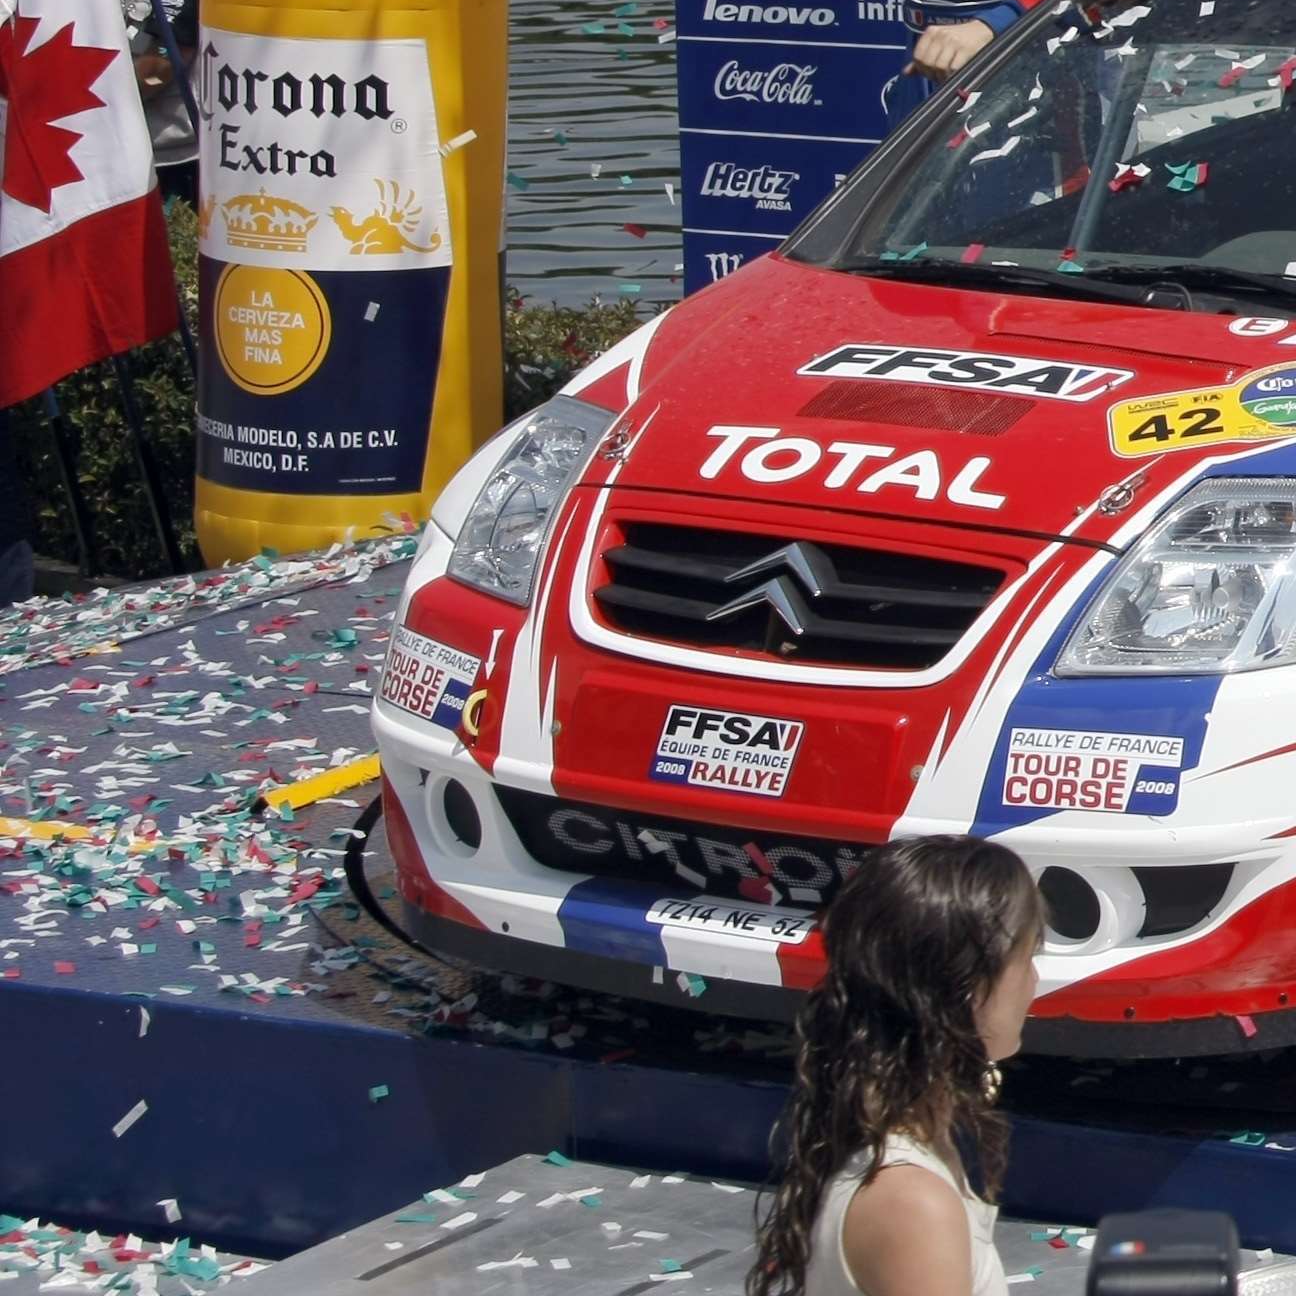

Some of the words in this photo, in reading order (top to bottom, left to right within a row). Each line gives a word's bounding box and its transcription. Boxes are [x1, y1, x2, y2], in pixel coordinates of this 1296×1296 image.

[714, 60, 818, 105] Coca-Cola
[219, 122, 338, 179] Extra
[701, 161, 798, 200] Hertz
[756, 199, 792, 211] AVASA
[251, 290, 275, 308] LA
[228, 306, 306, 329] CERVEZA
[244, 327, 284, 346] MAS
[244, 347, 284, 365] FINA
[809, 347, 1068, 396] FFSA
[237, 425, 302, 451] MODELO,
[306, 431, 336, 449] S.A
[340, 431, 363, 449] DE
[368, 429, 399, 448] C.V.
[1128, 407, 1225, 442] 42
[223, 447, 277, 473] MEXICO,
[281, 454, 310, 472] D.F.
[699, 424, 1008, 510] TOTAL
[390, 649, 420, 681] TOUR
[421, 664, 446, 691] DE
[421, 642, 438, 658] DE
[437, 648, 479, 675] FRANCE
[382, 670, 438, 717] CORSE
[665, 708, 782, 751] FFSA
[1012, 731, 1075, 749] RALLYE
[1079, 735, 1103, 751] DE
[1107, 736, 1182, 756] FRANCE
[659, 737, 709, 758] ÉQUIPE
[712, 747, 730, 761] DE
[735, 750, 790, 770] FRANCE
[1010, 752, 1082, 778] TOUR
[1091, 757, 1129, 781] DE
[655, 761, 687, 776] 2008
[691, 761, 785, 792] RALLYE
[1005, 775, 1126, 810] CORSE
[1135, 780, 1176, 795] 2008
[723, 910, 765, 931] NE
[770, 917, 806, 938] 52
